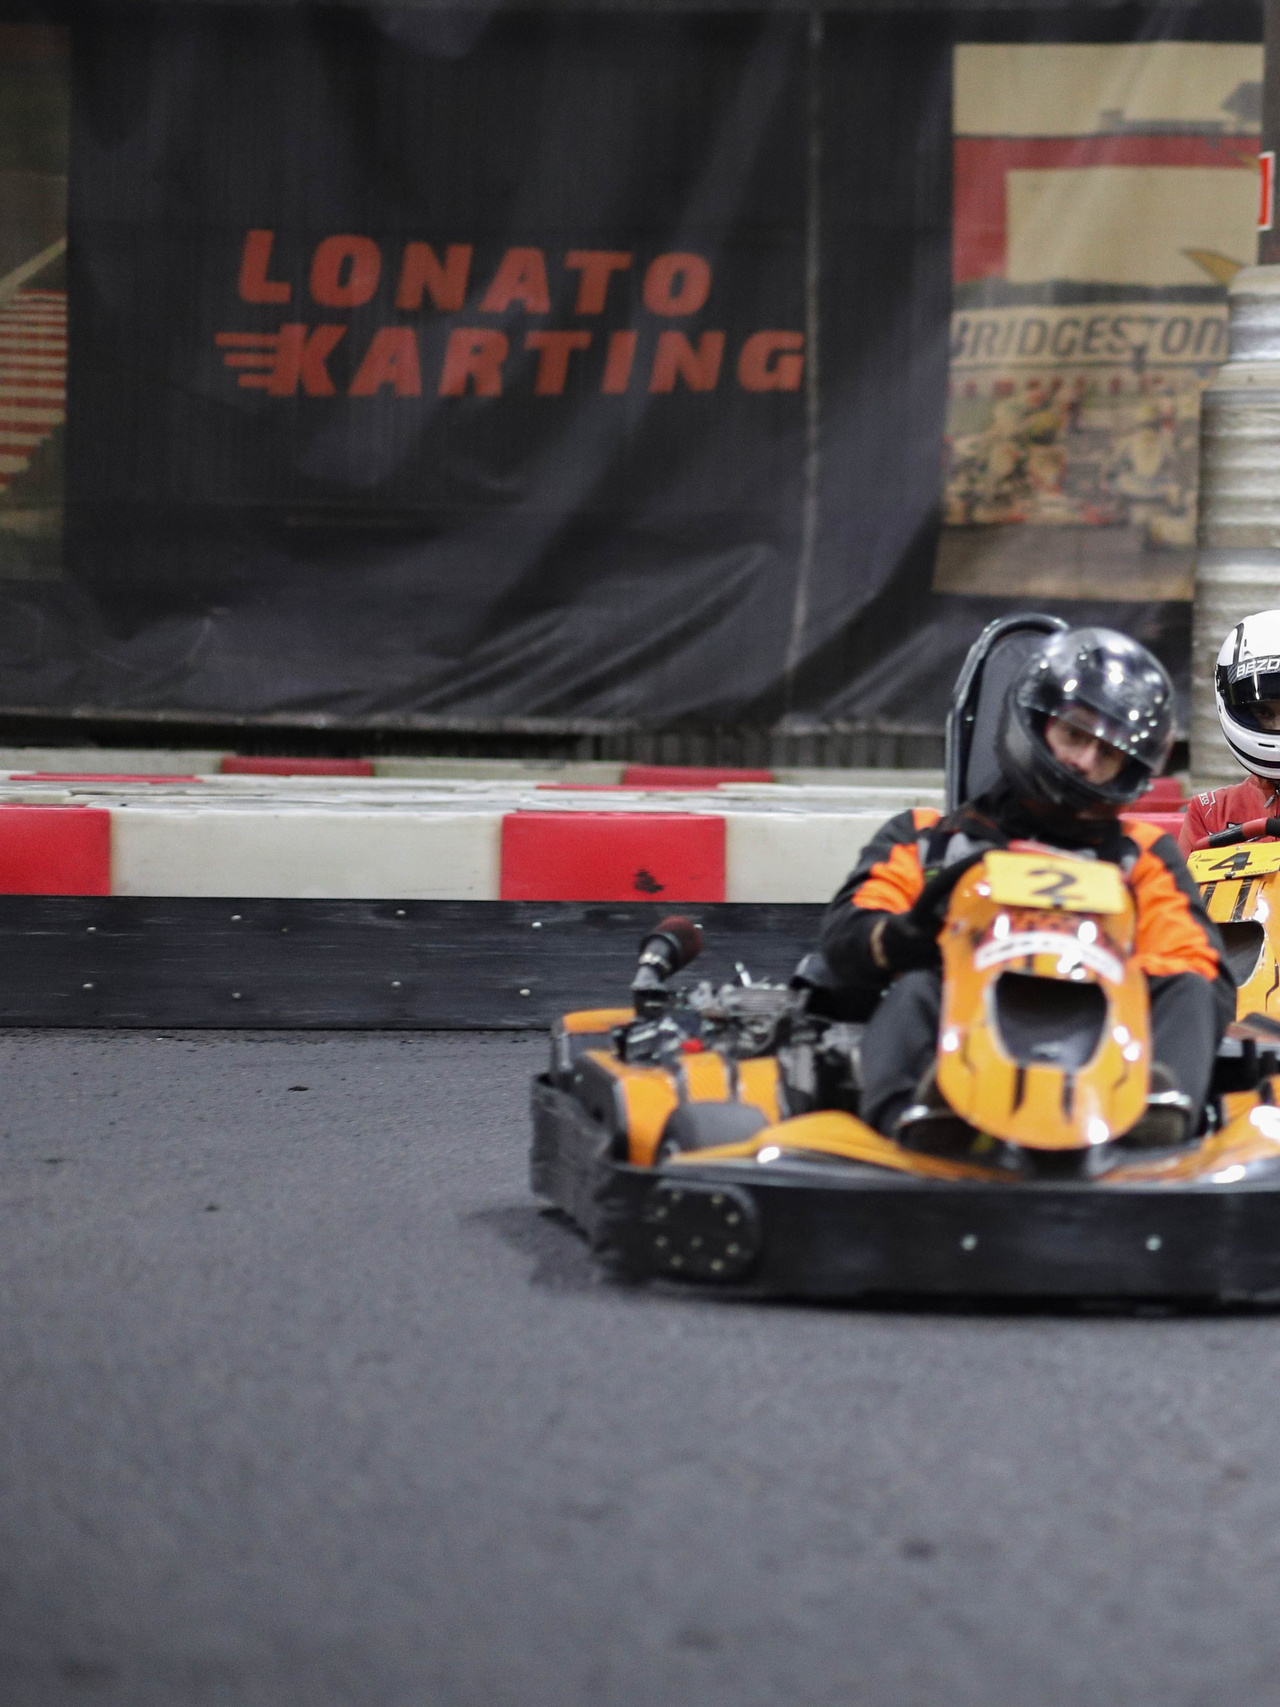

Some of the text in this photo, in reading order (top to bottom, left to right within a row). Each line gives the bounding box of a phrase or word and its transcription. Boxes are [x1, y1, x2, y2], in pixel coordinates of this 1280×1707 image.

[238, 229, 712, 318] LONATO
[266, 323, 805, 398] KARTING
[1028, 868, 1086, 901] 2
[1208, 851, 1252, 872] 4
